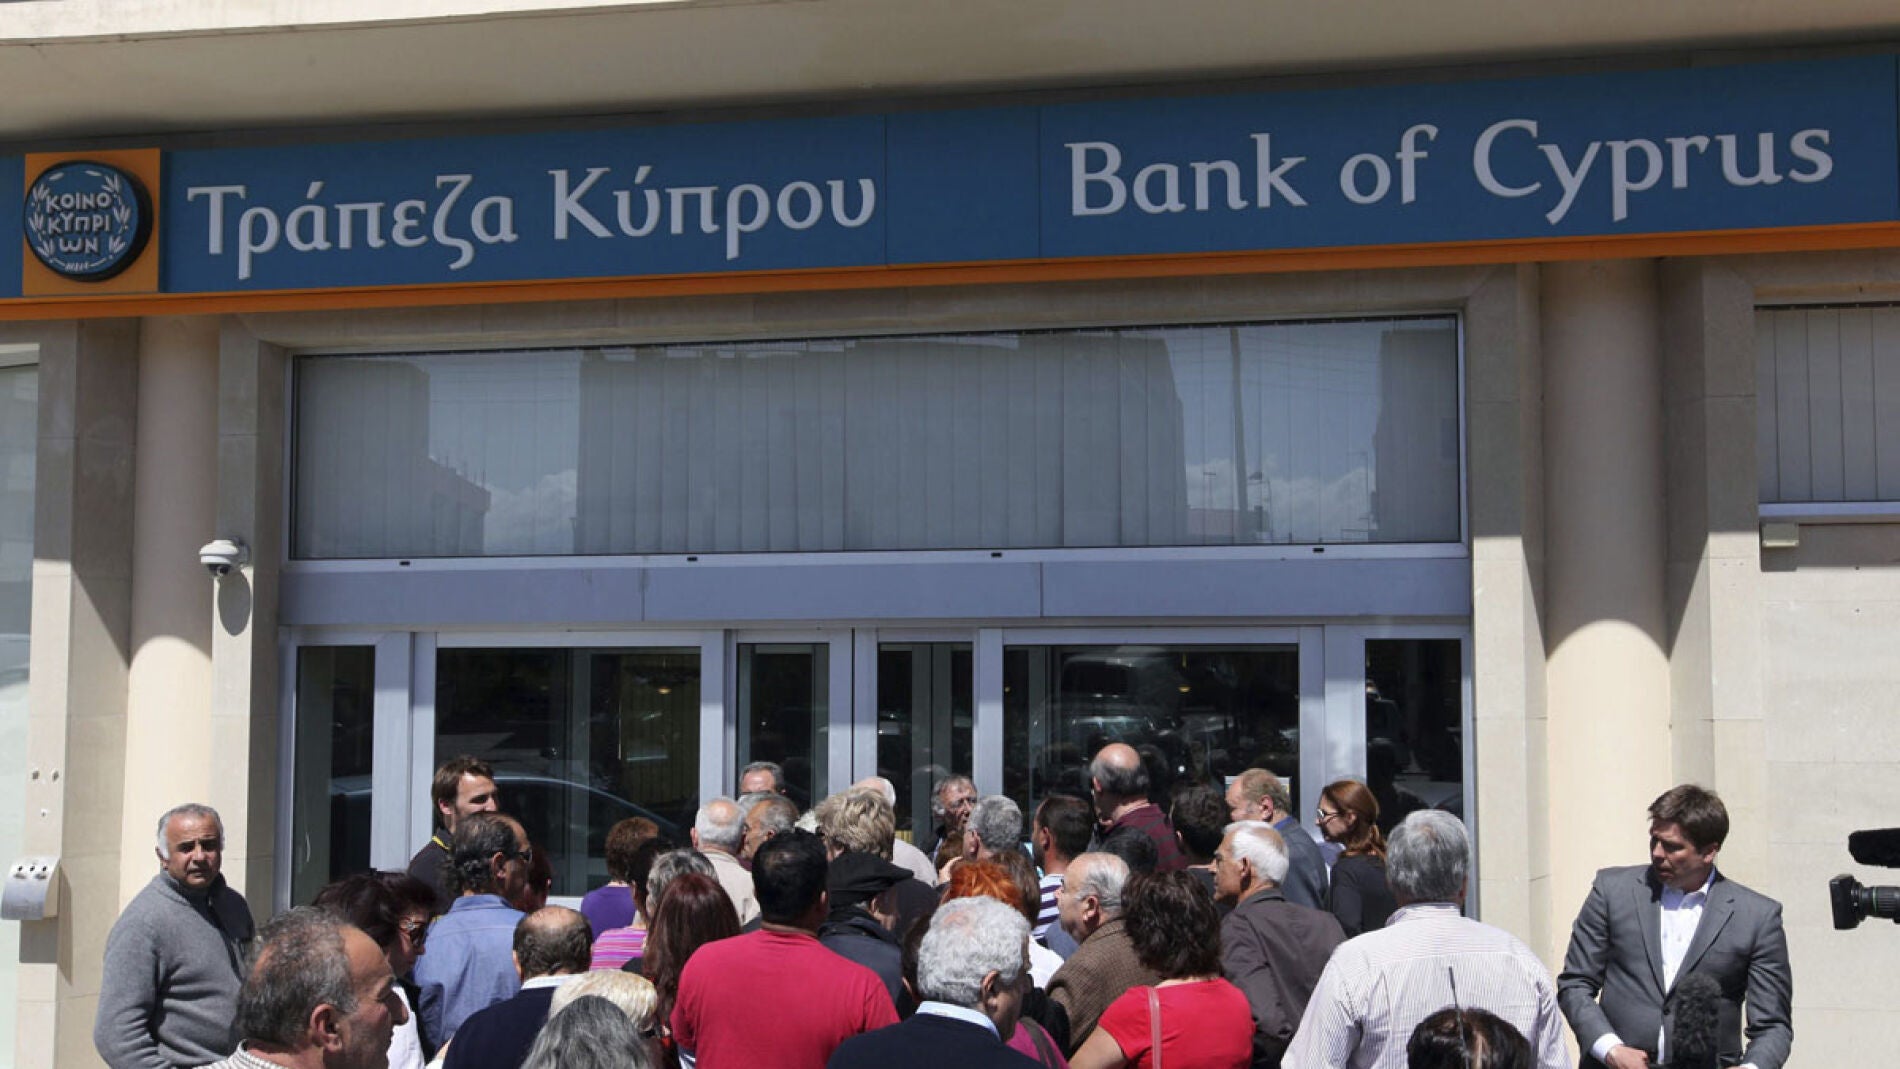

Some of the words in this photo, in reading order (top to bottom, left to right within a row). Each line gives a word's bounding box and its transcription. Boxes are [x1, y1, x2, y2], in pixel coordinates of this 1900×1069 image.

[46, 192, 112, 214] ΚΟΙΝΟ
[1066, 132, 1308, 216] Bank
[1340, 124, 1438, 204] of
[1472, 119, 1834, 225] Cyprus
[48, 211, 111, 234] ΚΥΠΡΙ
[186, 174, 518, 281] Τράπεζα
[549, 165, 876, 262] Κύπρου
